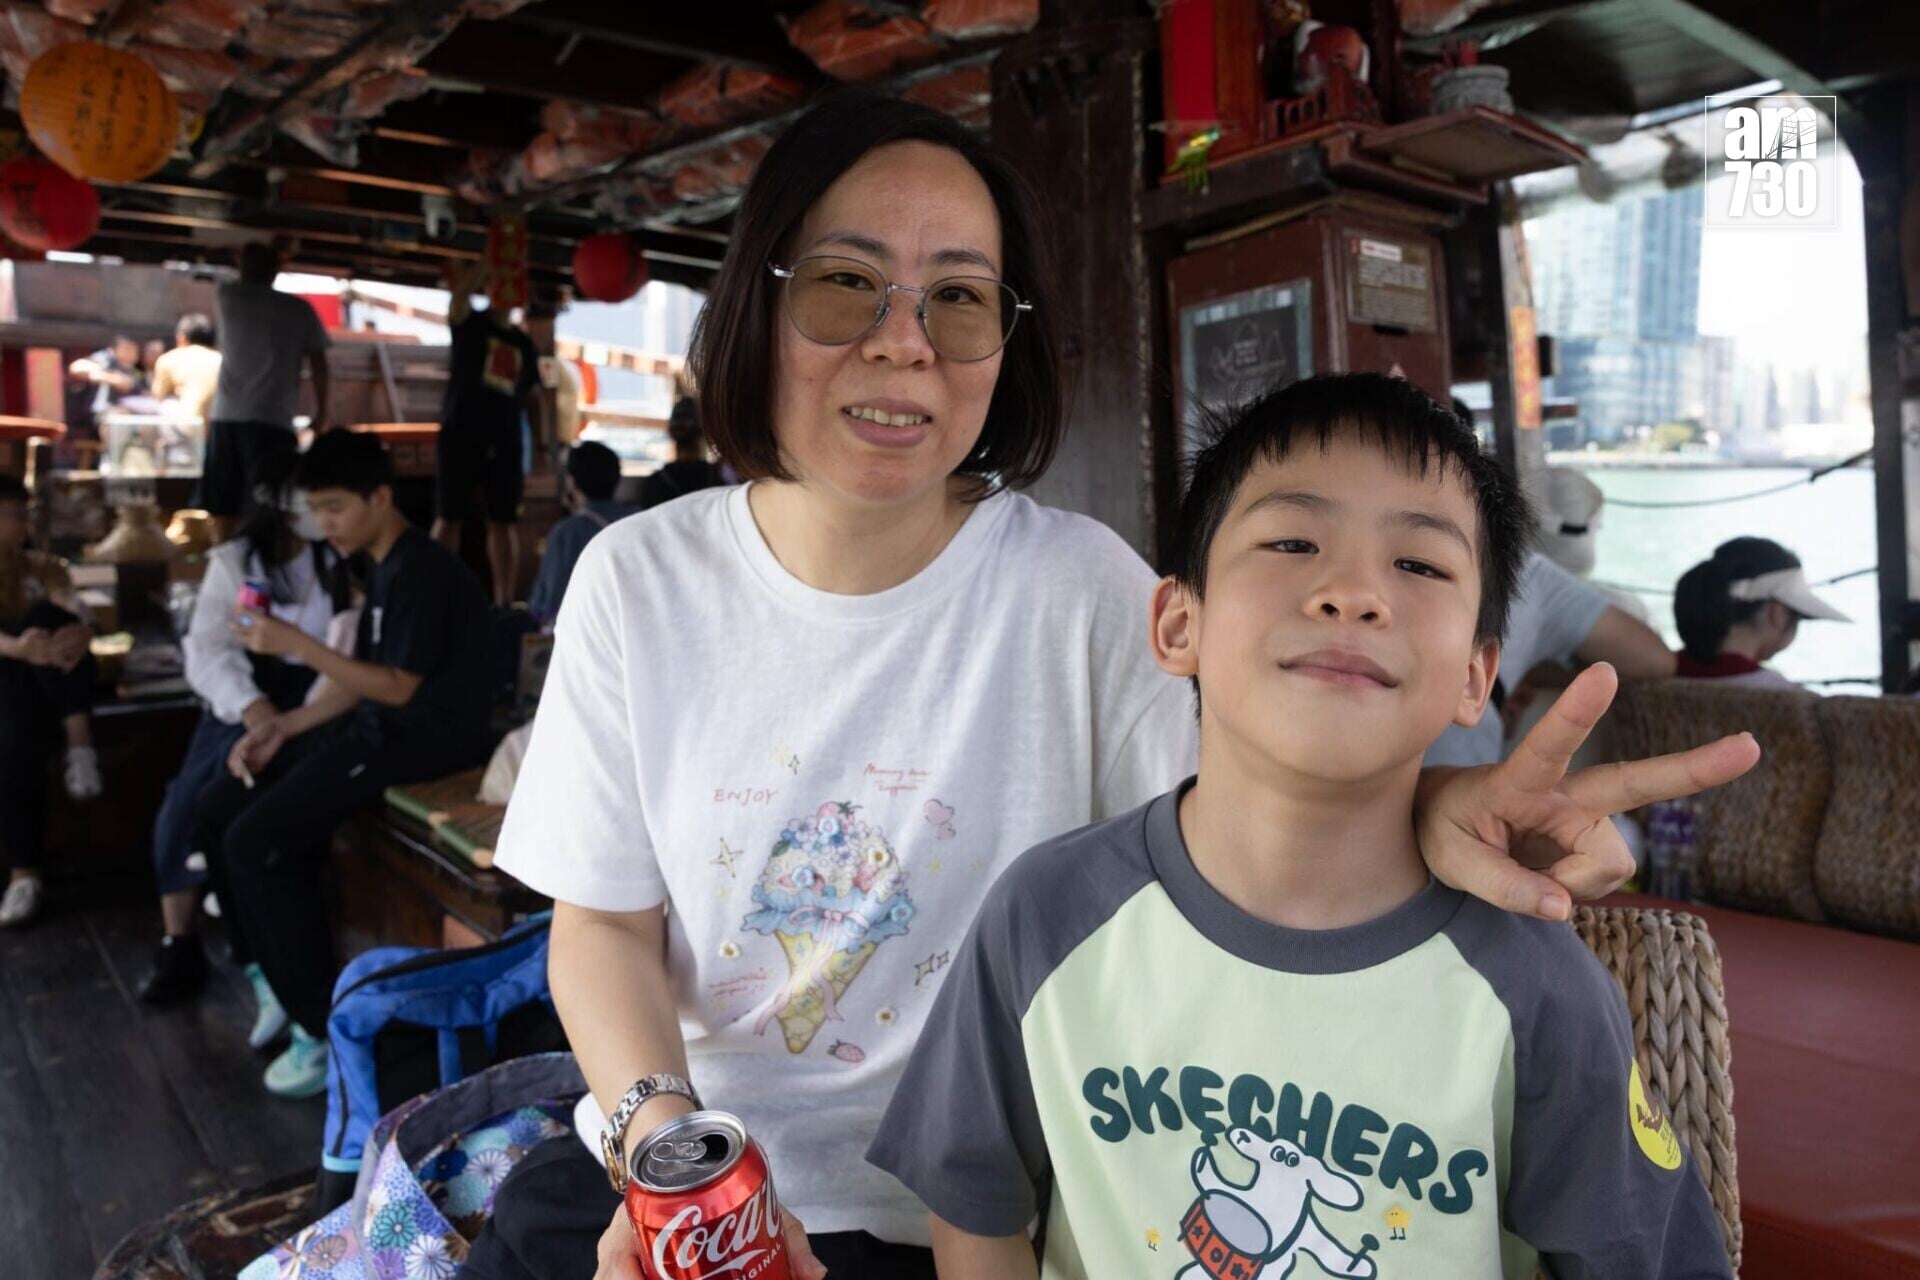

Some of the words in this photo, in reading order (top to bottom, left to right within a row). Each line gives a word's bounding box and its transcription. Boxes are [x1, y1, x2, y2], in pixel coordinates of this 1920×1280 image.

[714, 788, 778, 806] ENJOY
[1082, 1065, 1489, 1214] SKECHERS
[733, 1242, 781, 1280] IGINAL
